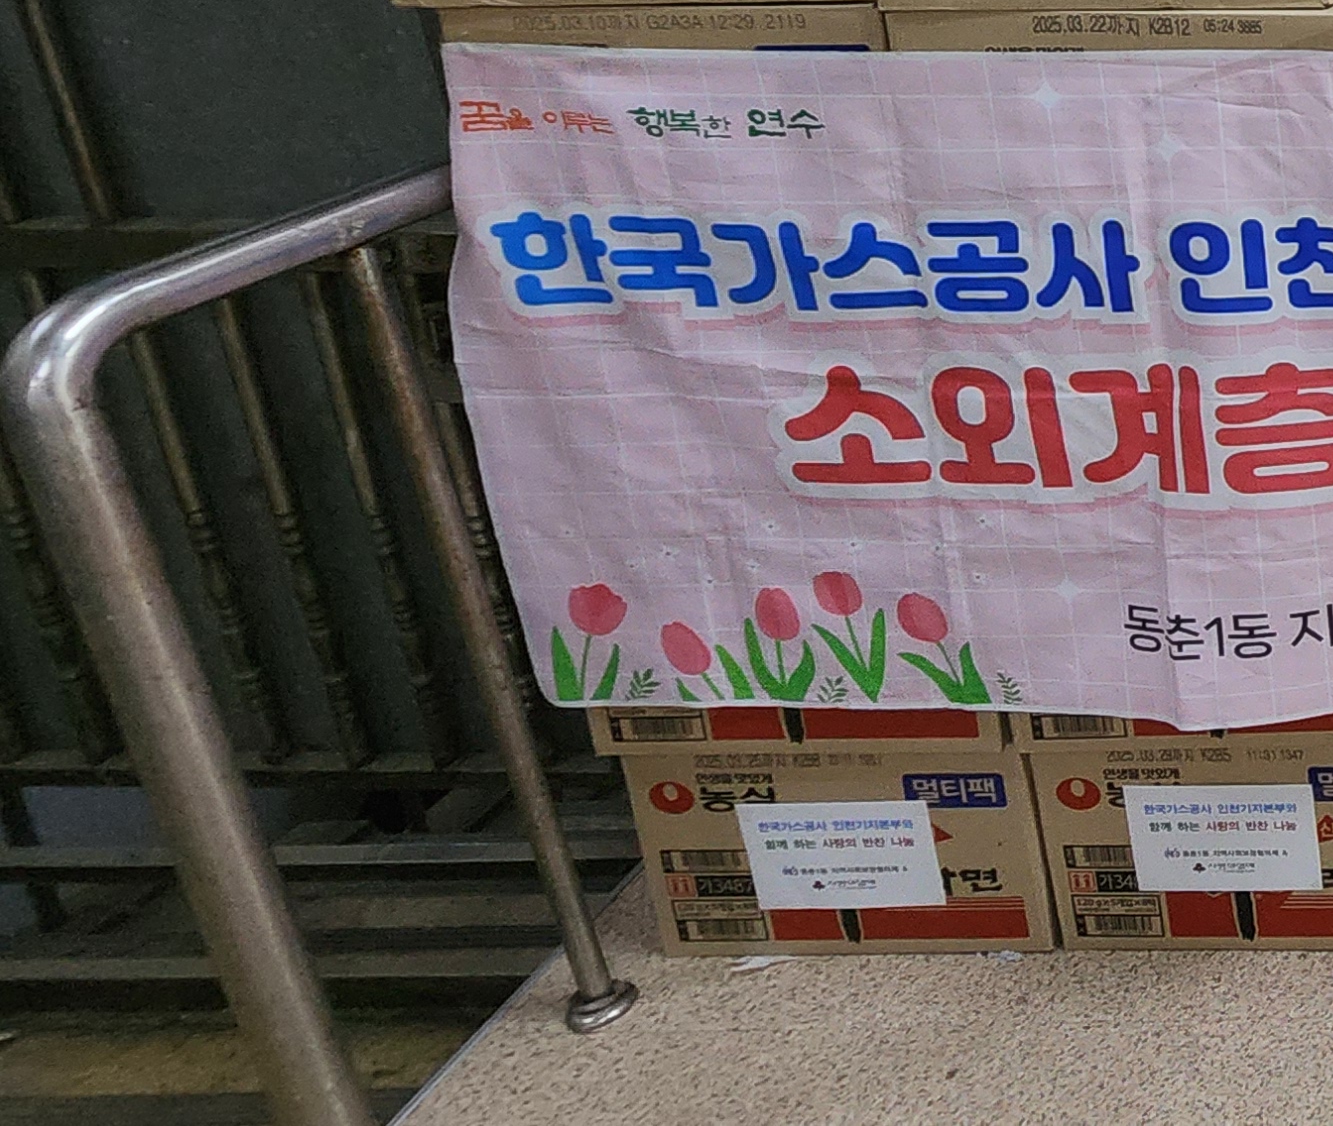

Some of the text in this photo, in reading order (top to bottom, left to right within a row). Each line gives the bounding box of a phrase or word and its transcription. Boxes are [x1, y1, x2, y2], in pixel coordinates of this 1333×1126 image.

[542, 109, 615, 134] 이루는
[626, 106, 732, 138] 행복한
[747, 108, 826, 139] 연수
[490, 211, 1141, 314] 한국가스공사
[1123, 604, 1278, 661] 동춘1동
[911, 778, 998, 804] 멀티팩
